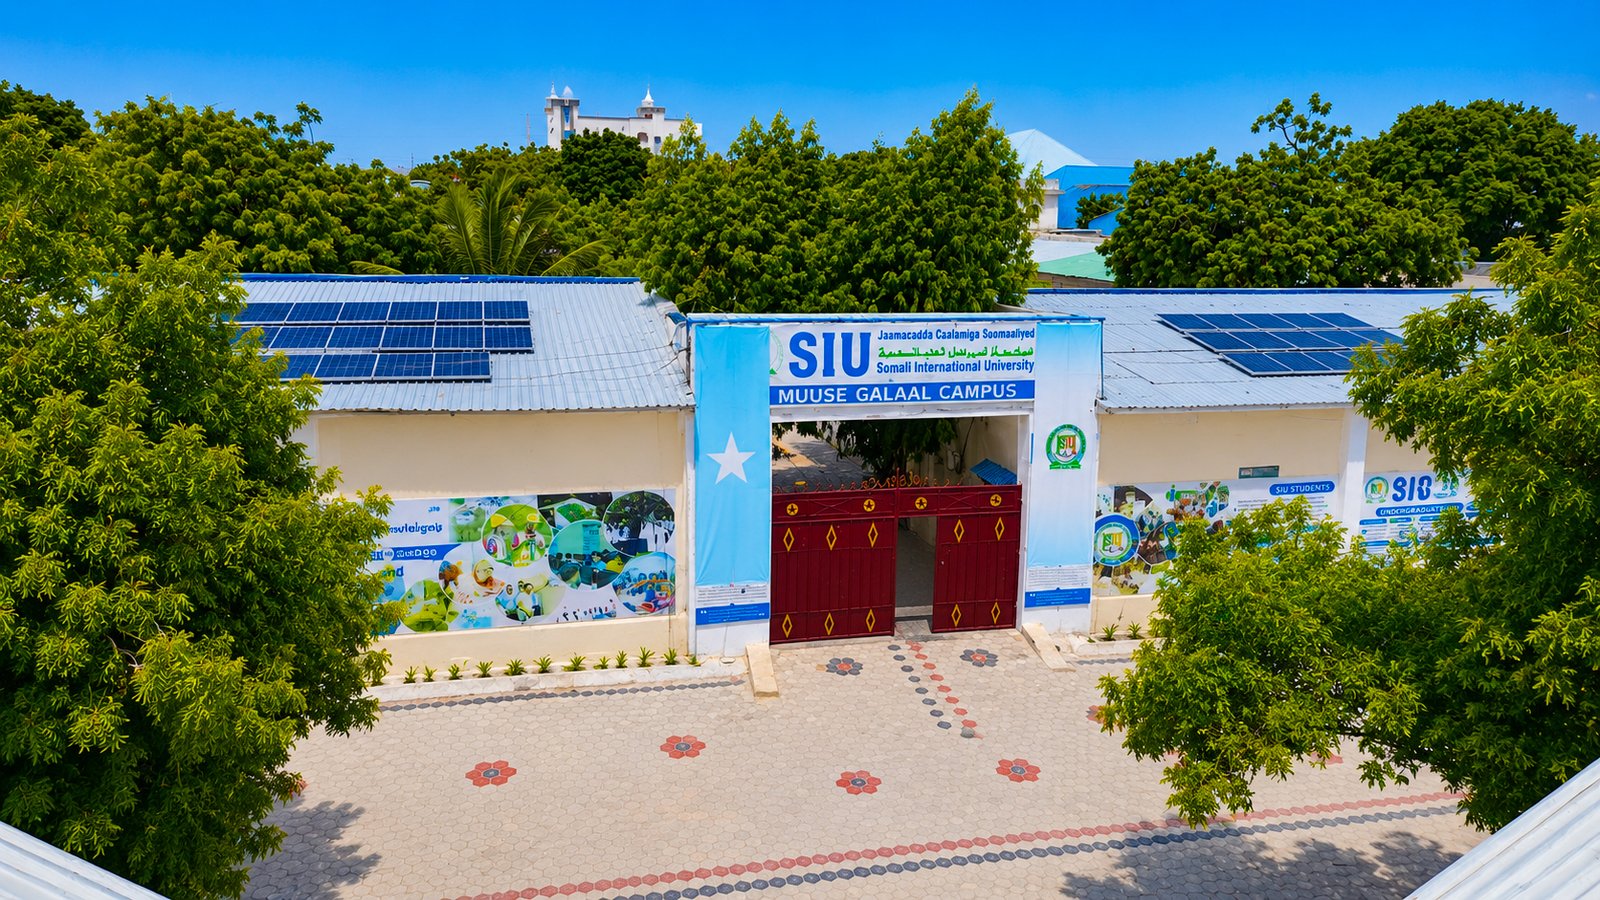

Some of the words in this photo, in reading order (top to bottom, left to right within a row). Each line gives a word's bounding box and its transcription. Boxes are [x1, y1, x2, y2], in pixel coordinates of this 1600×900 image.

[878, 329, 933, 340] Jaamacadda
[935, 328, 980, 341] Caalamiga
[982, 327, 1035, 341] Soomaaliyed
[788, 331, 871, 378] SIU
[876, 361, 911, 373] Somali
[914, 360, 981, 373] International
[984, 359, 1035, 373] University
[778, 387, 847, 404] MUUSE
[856, 386, 931, 402] GALAAL
[939, 384, 1017, 399] CAMPUS
[1275, 486, 1289, 494] SIU
[1290, 483, 1331, 493] STUDENTS
